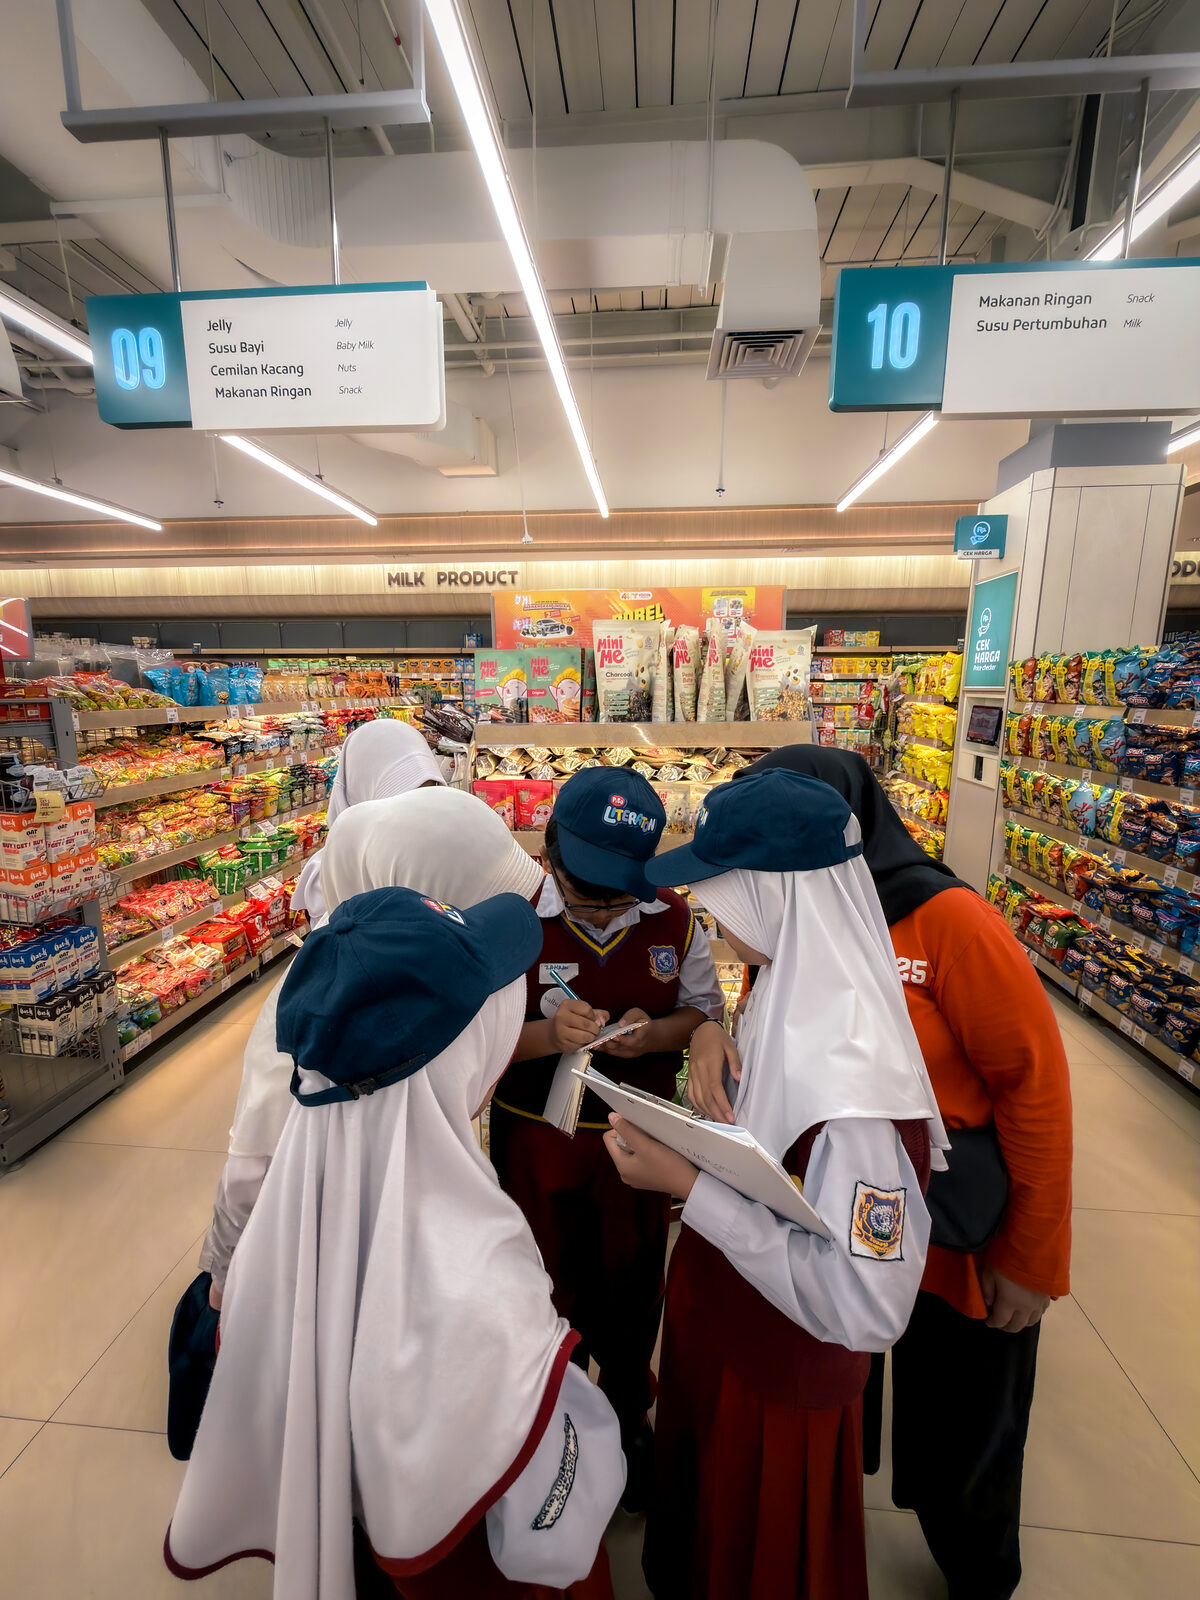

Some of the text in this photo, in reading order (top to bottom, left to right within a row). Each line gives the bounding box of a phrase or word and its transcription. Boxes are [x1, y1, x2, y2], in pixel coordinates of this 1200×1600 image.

[979, 293, 1092, 309] Makanan Ringan
[1127, 293, 1155, 303] Snack
[207, 320, 232, 334] Jelly
[335, 318, 353, 329] Jelly
[976, 317, 1107, 332] Susu Pertumbuhan
[1123, 318, 1142, 328] Milk
[867, 302, 921, 369] 10
[209, 342, 264, 354] Susu Bayi
[336, 340, 374, 351] Baby Milk
[110, 327, 167, 391] 09
[211, 364, 304, 377] Cemilan Kacang
[337, 364, 357, 372] Nuts
[215, 385, 312, 400] Makanan Ringan
[339, 385, 363, 395] Snack
[387, 570, 518, 587] MILK PRODUCT
[597, 635, 623, 652] Mini
[976, 639, 990, 650] CEK
[531, 656, 549, 668] Mini
[600, 649, 624, 668] Me
[974, 651, 1000, 663] HARGA
[480, 660, 498, 671] Mini
[532, 665, 550, 679] Me
[481, 668, 498, 680] Me
[604, 806, 655, 832] LITERATON
[1029, 921, 1042, 935] avy
